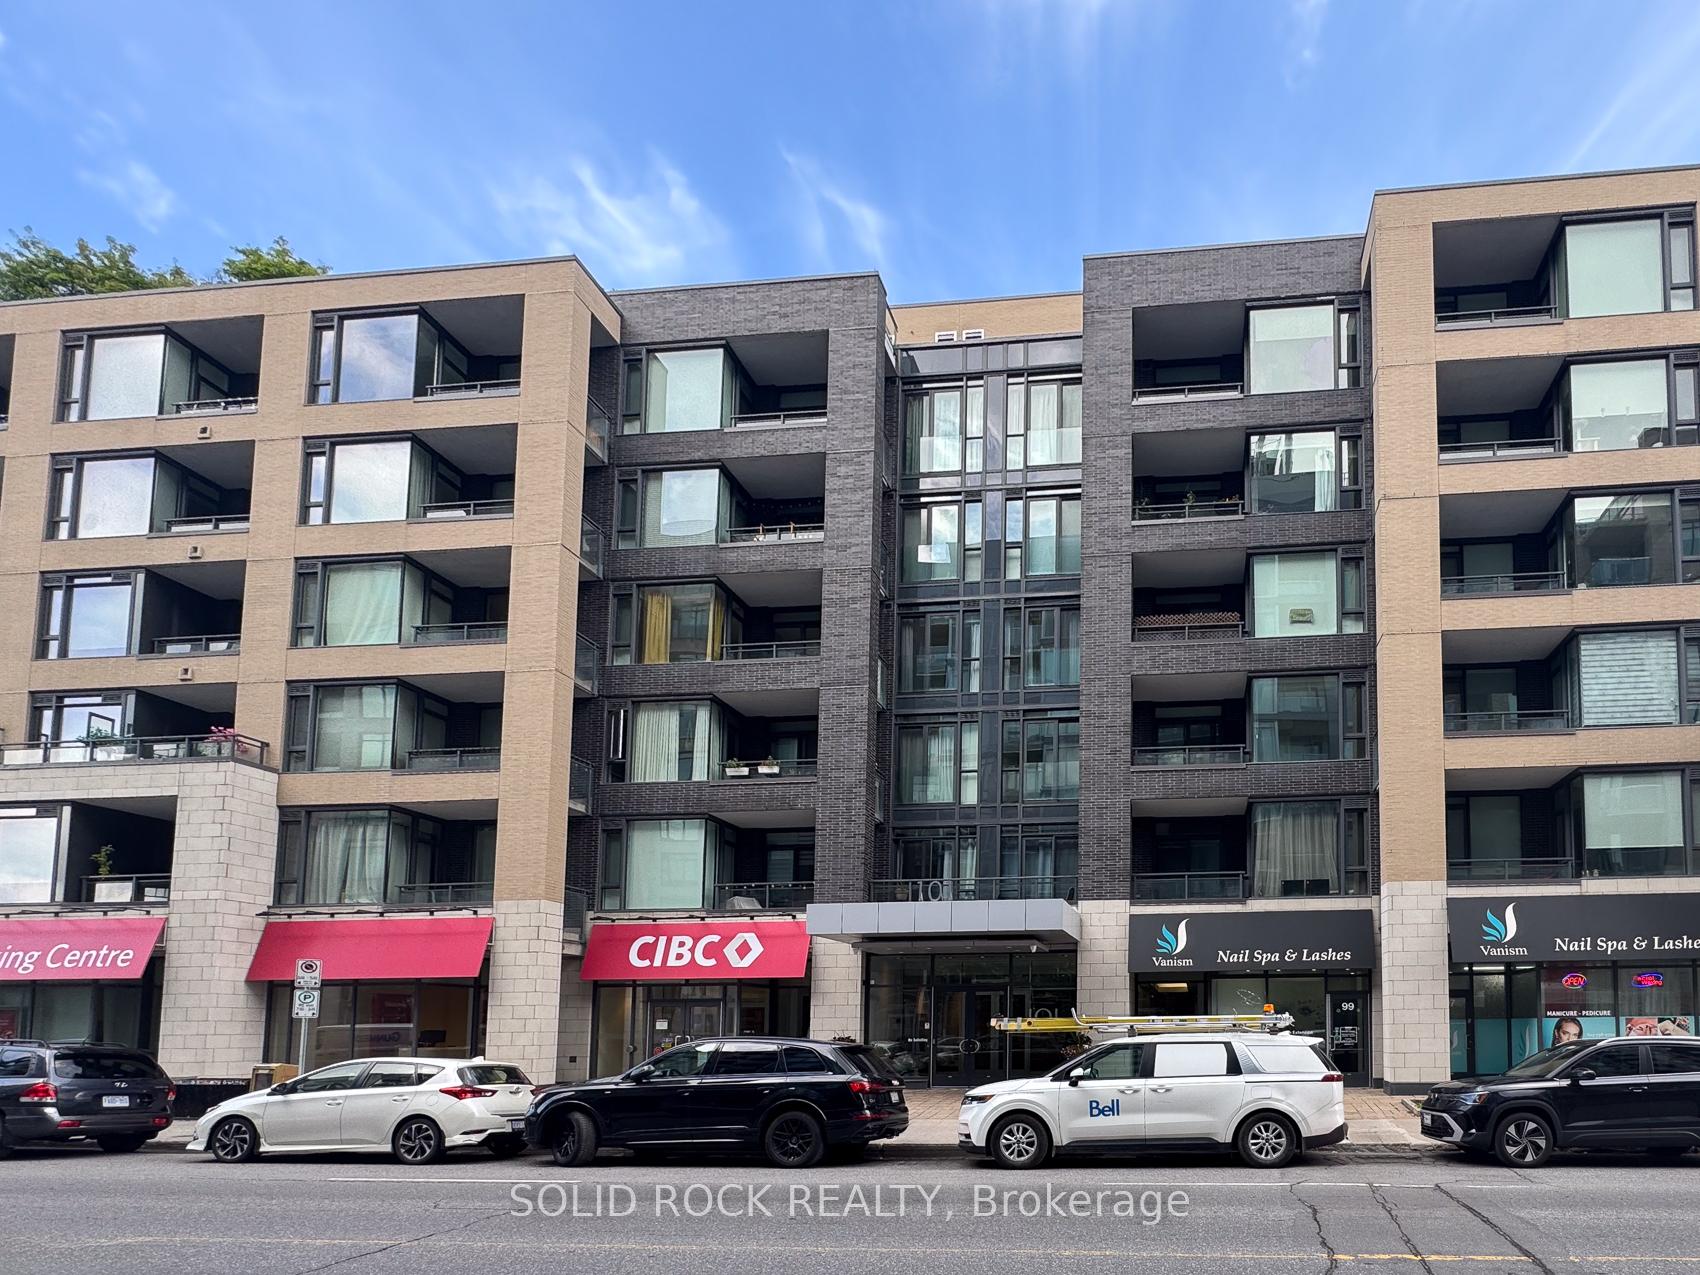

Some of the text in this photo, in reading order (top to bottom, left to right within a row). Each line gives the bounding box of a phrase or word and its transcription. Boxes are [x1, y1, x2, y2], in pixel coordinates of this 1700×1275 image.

[628, 934, 722, 968] CIBC
[1479, 944, 1529, 956] Vanism
[1554, 936, 1592, 952] Nail
[1596, 937, 1628, 955] Spa
[1632, 936, 1648, 951] &
[0, 943, 134, 974] ing Centre
[1152, 956, 1194, 967] Vanism
[1216, 948, 1352, 966] Nail Spa & Lashes
[1563, 976, 1585, 986] OPEN
[1341, 1002, 1355, 1011] 99
[1088, 1098, 1120, 1118] Bell
